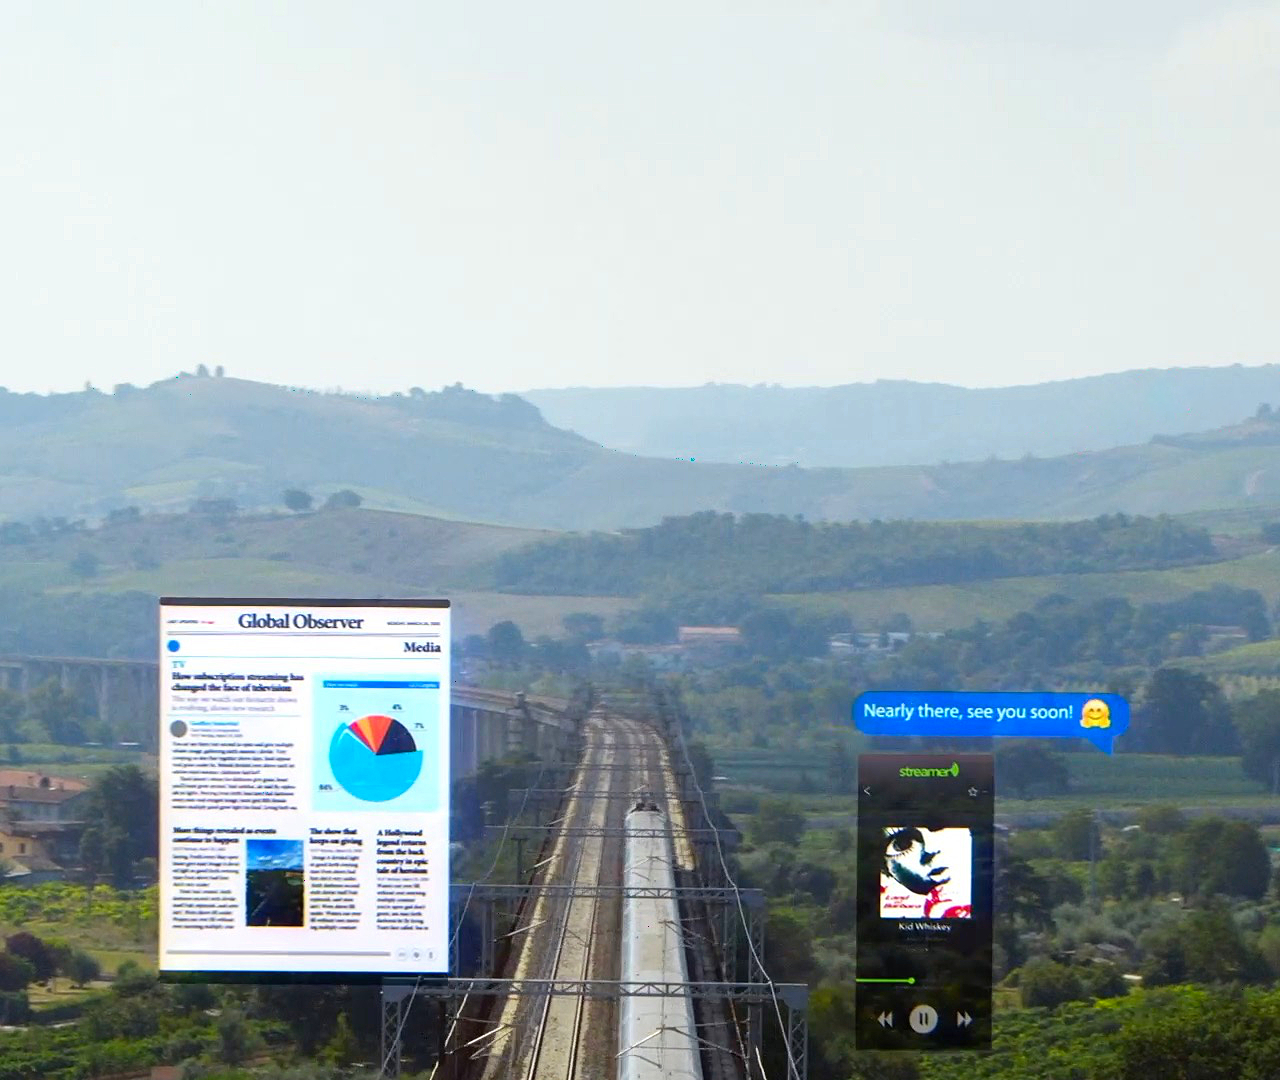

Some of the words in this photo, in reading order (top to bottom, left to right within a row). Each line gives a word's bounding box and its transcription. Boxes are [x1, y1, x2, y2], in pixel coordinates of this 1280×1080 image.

[238, 614, 289, 628] Global
[293, 614, 364, 629] Observer
[404, 642, 441, 652] Media
[172, 672, 191, 680] How
[194, 672, 245, 682] subscription
[247, 673, 288, 682] streaming
[172, 684, 206, 693] changed
[252, 684, 292, 692] television
[864, 704, 913, 720] Nearly
[918, 705, 963, 720] there,
[967, 708, 993, 719] see
[997, 707, 1026, 722] you
[1030, 705, 1073, 719] soon!
[899, 765, 951, 777] streamer
[341, 838, 362, 846] giving
[377, 839, 399, 847] legend
[898, 922, 914, 930] Kid
[915, 922, 952, 931] Whiskey
